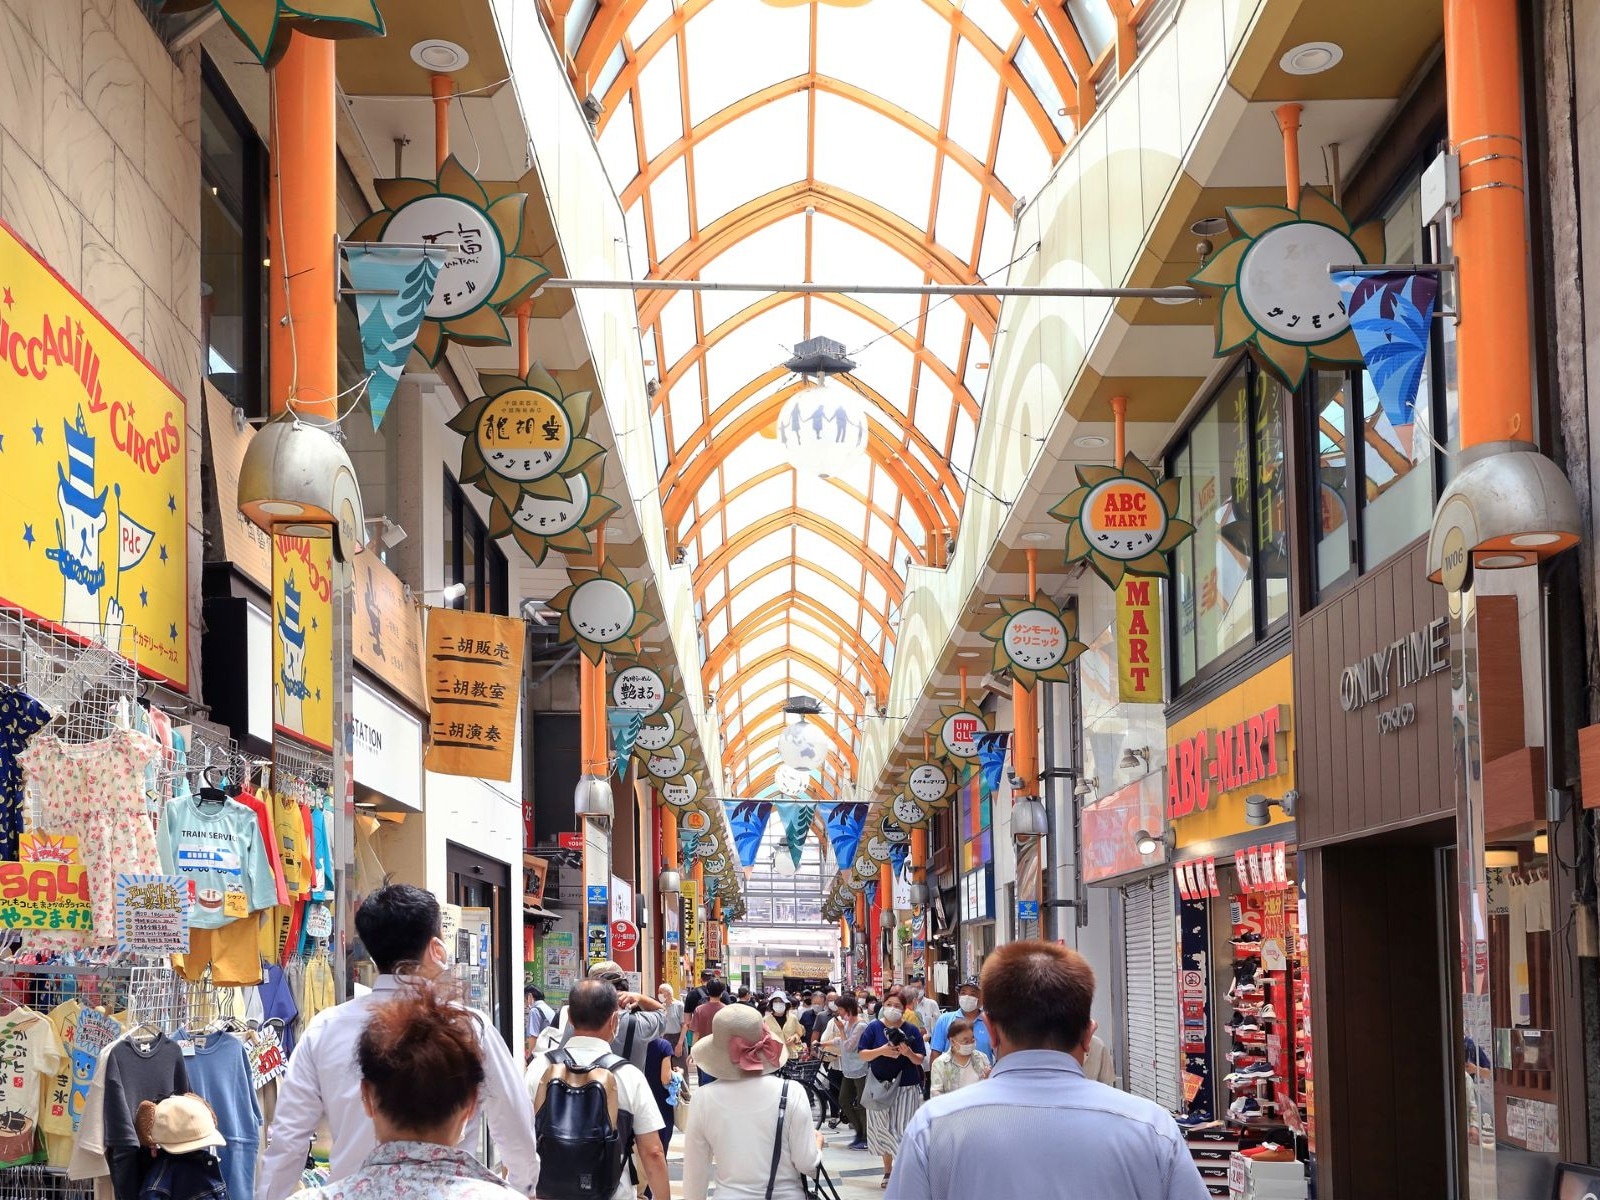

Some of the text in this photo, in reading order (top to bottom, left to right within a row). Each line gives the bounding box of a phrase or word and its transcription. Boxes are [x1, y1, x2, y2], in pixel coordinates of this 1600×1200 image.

[422, 222, 482, 256] 富
[492, 450, 552, 470] サンモール
[1104, 493, 1147, 512] ABC
[1104, 514, 1148, 528] MART
[1098, 533, 1153, 551] サンモール
[1444, 547, 1464, 573] W06
[579, 622, 621, 636] サンモール
[1013, 624, 1060, 636] サンモール
[439, 636, 510, 660] 二胡販売
[1012, 636, 1059, 648] クリニック
[1015, 650, 1056, 664] サンモール
[436, 678, 506, 700] 二胡教室
[433, 722, 502, 743] 二胡演奏
[956, 722, 974, 731] UNI
[949, 742, 974, 754] サンモー
[181, 830, 207, 838] TRAIN
[13, 1030, 28, 1074] かぶと
[53, 1073, 69, 1104] き氷
